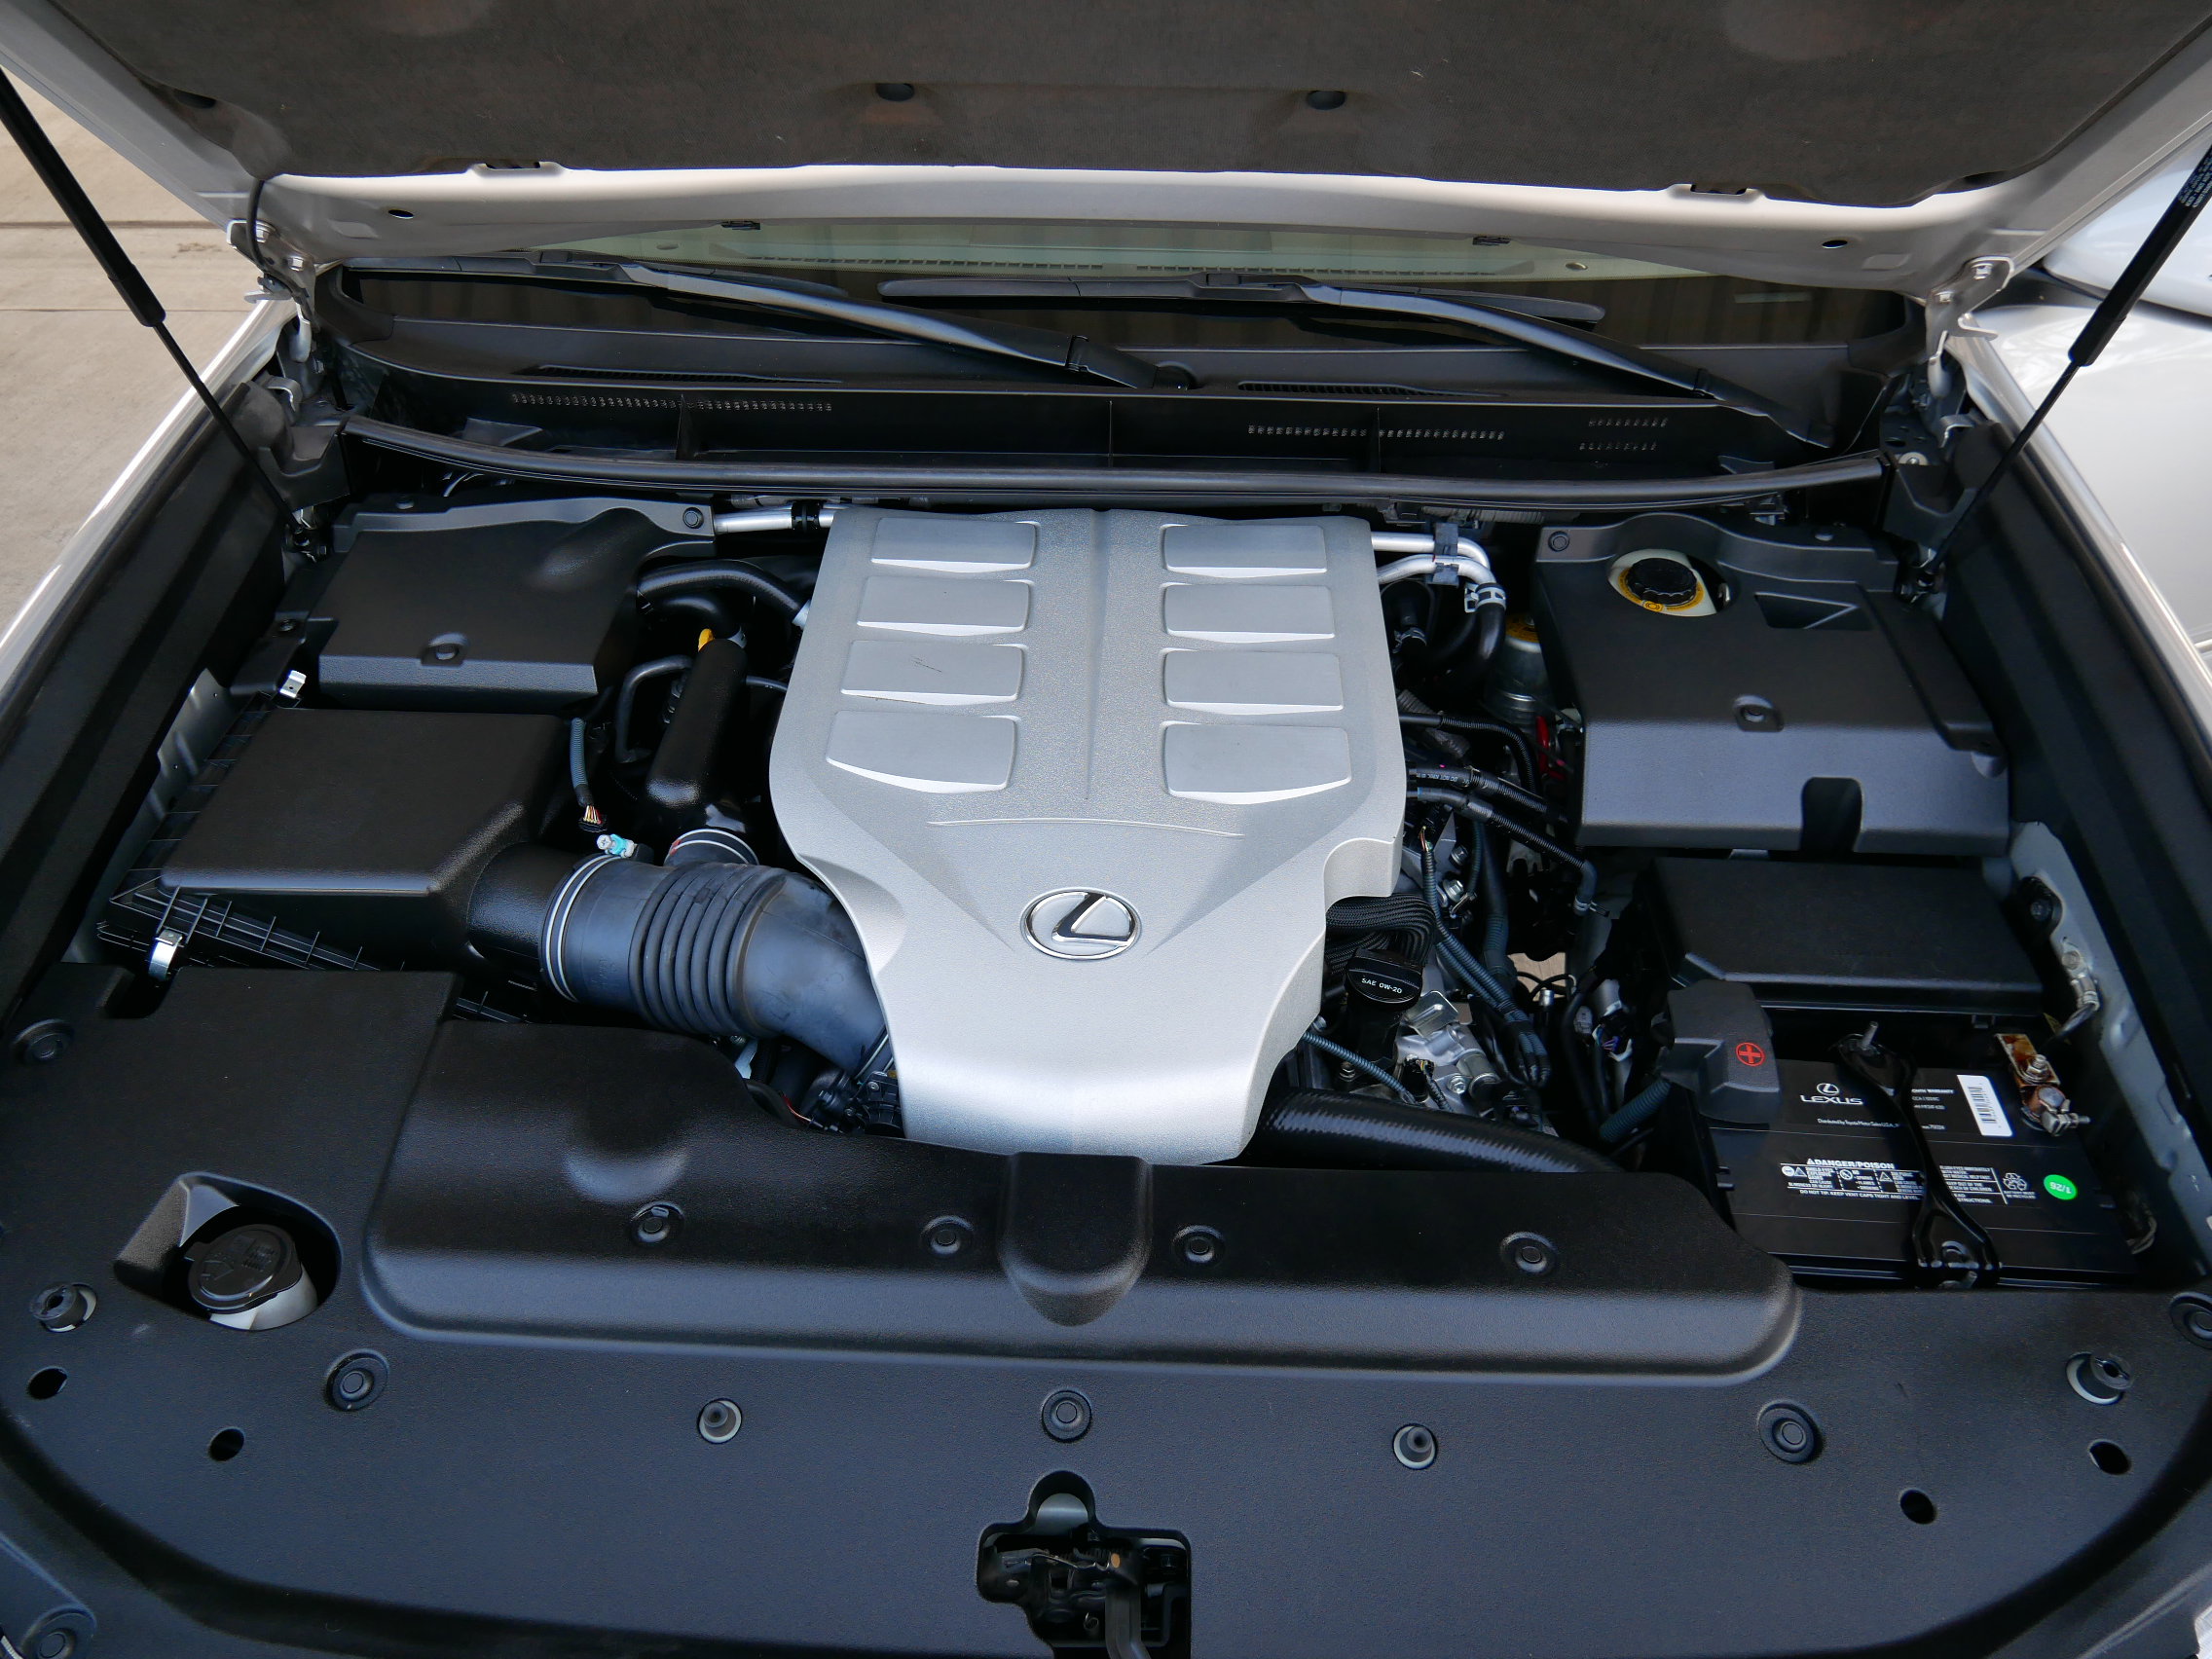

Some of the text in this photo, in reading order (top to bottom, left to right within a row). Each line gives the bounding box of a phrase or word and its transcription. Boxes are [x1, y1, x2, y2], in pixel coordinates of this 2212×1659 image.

[1361, 977, 1378, 986] SAE
[1799, 1094, 1864, 1106] LEXUS
[1813, 1159, 1896, 1169] DANGER/POISON
